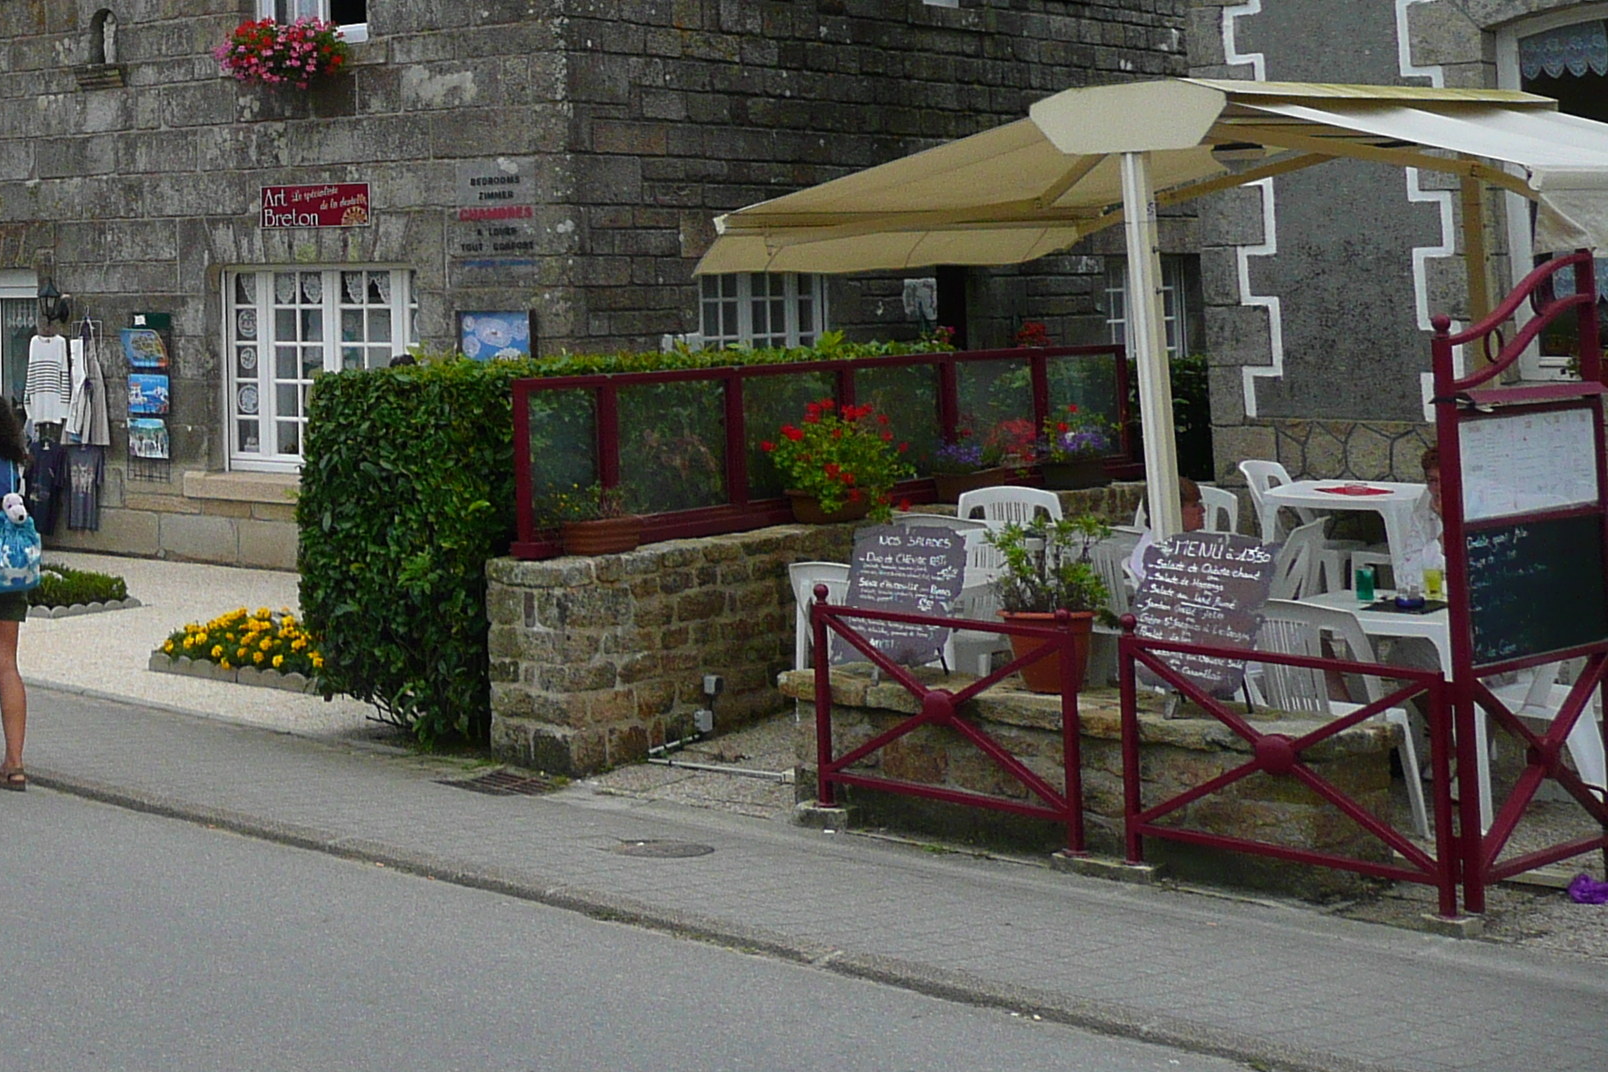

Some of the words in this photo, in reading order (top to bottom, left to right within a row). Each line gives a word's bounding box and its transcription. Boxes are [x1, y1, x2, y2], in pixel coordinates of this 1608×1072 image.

[470, 175, 520, 186] BEDROOMS
[264, 189, 288, 208] Art
[478, 190, 514, 201] ZIMMER
[264, 208, 319, 226] Breton
[461, 242, 483, 252] TOUT
